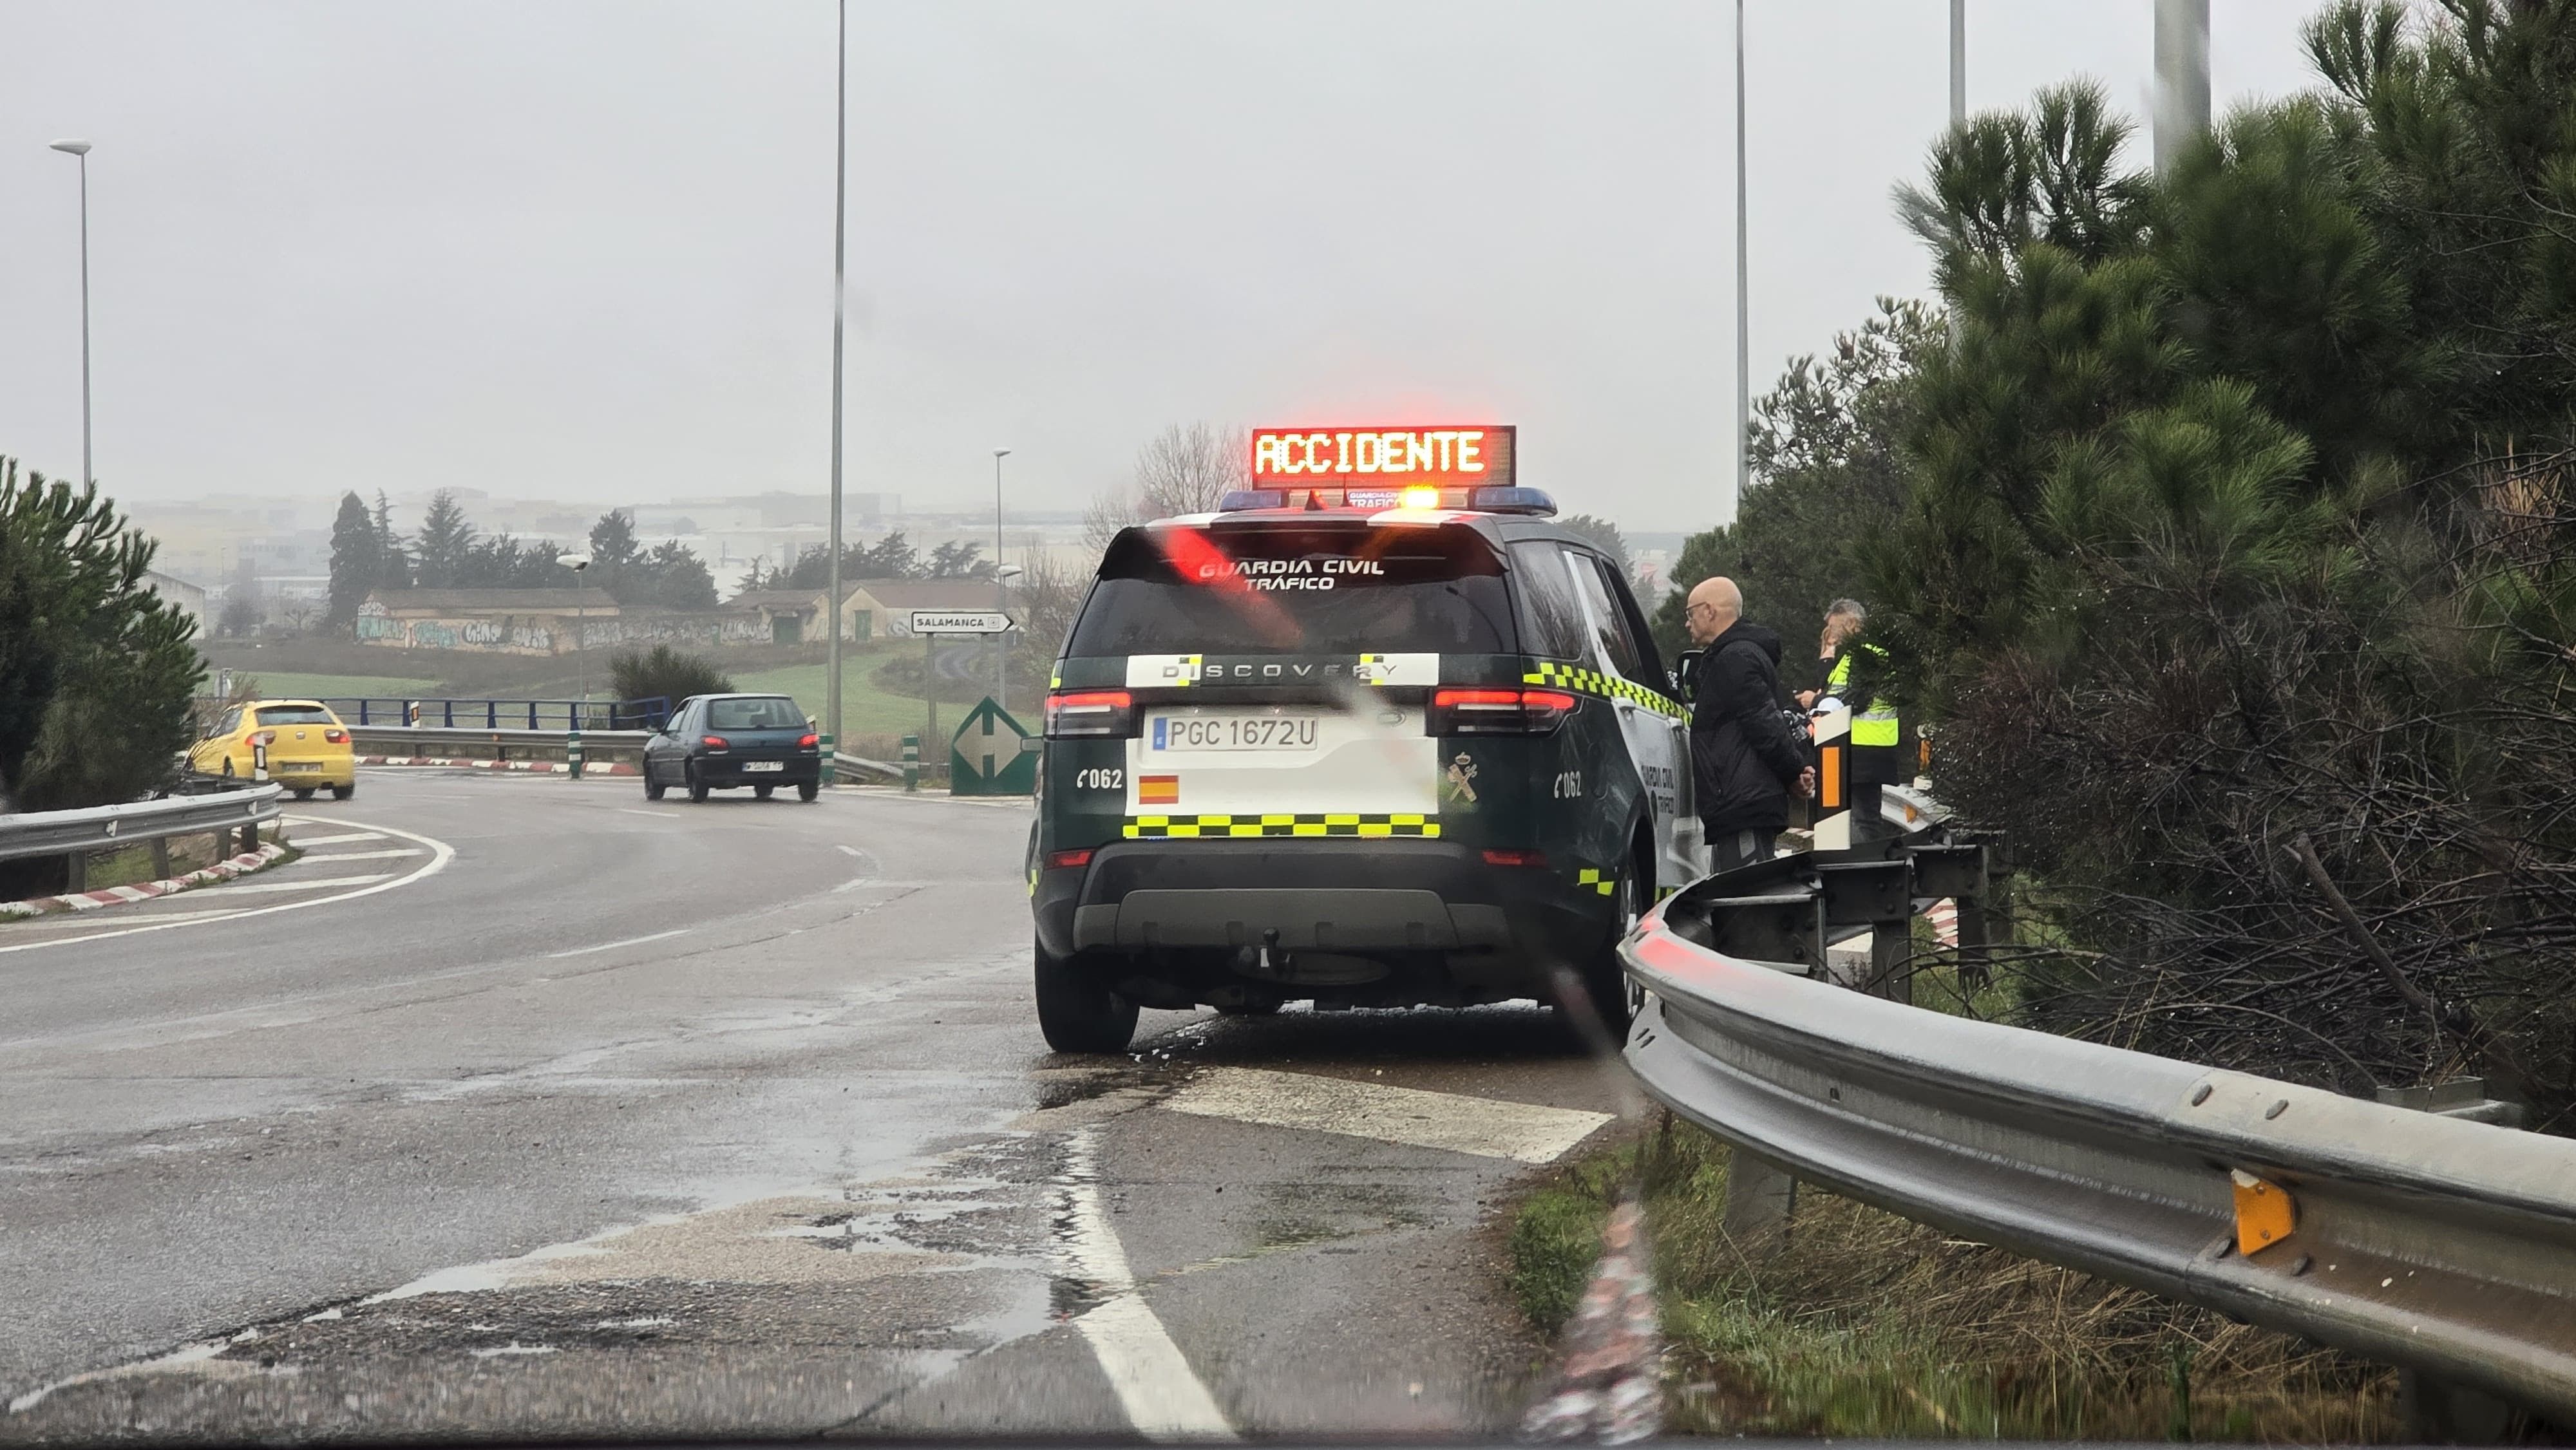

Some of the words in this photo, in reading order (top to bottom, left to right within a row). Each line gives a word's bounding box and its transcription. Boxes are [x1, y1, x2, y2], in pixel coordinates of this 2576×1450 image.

[1255, 431, 1484, 474] ACCIDENTE
[1198, 560, 1313, 578] GUARDIA
[1322, 560, 1385, 575] CIVIL
[1244, 576, 1335, 590] TRÁFICO
[916, 618, 984, 626] SALAMANCA
[1162, 664, 1397, 679] DISCOVERY
[1170, 720, 1221, 746] PGC
[1090, 768, 1122, 789] 062
[1563, 771, 1582, 798] 062
